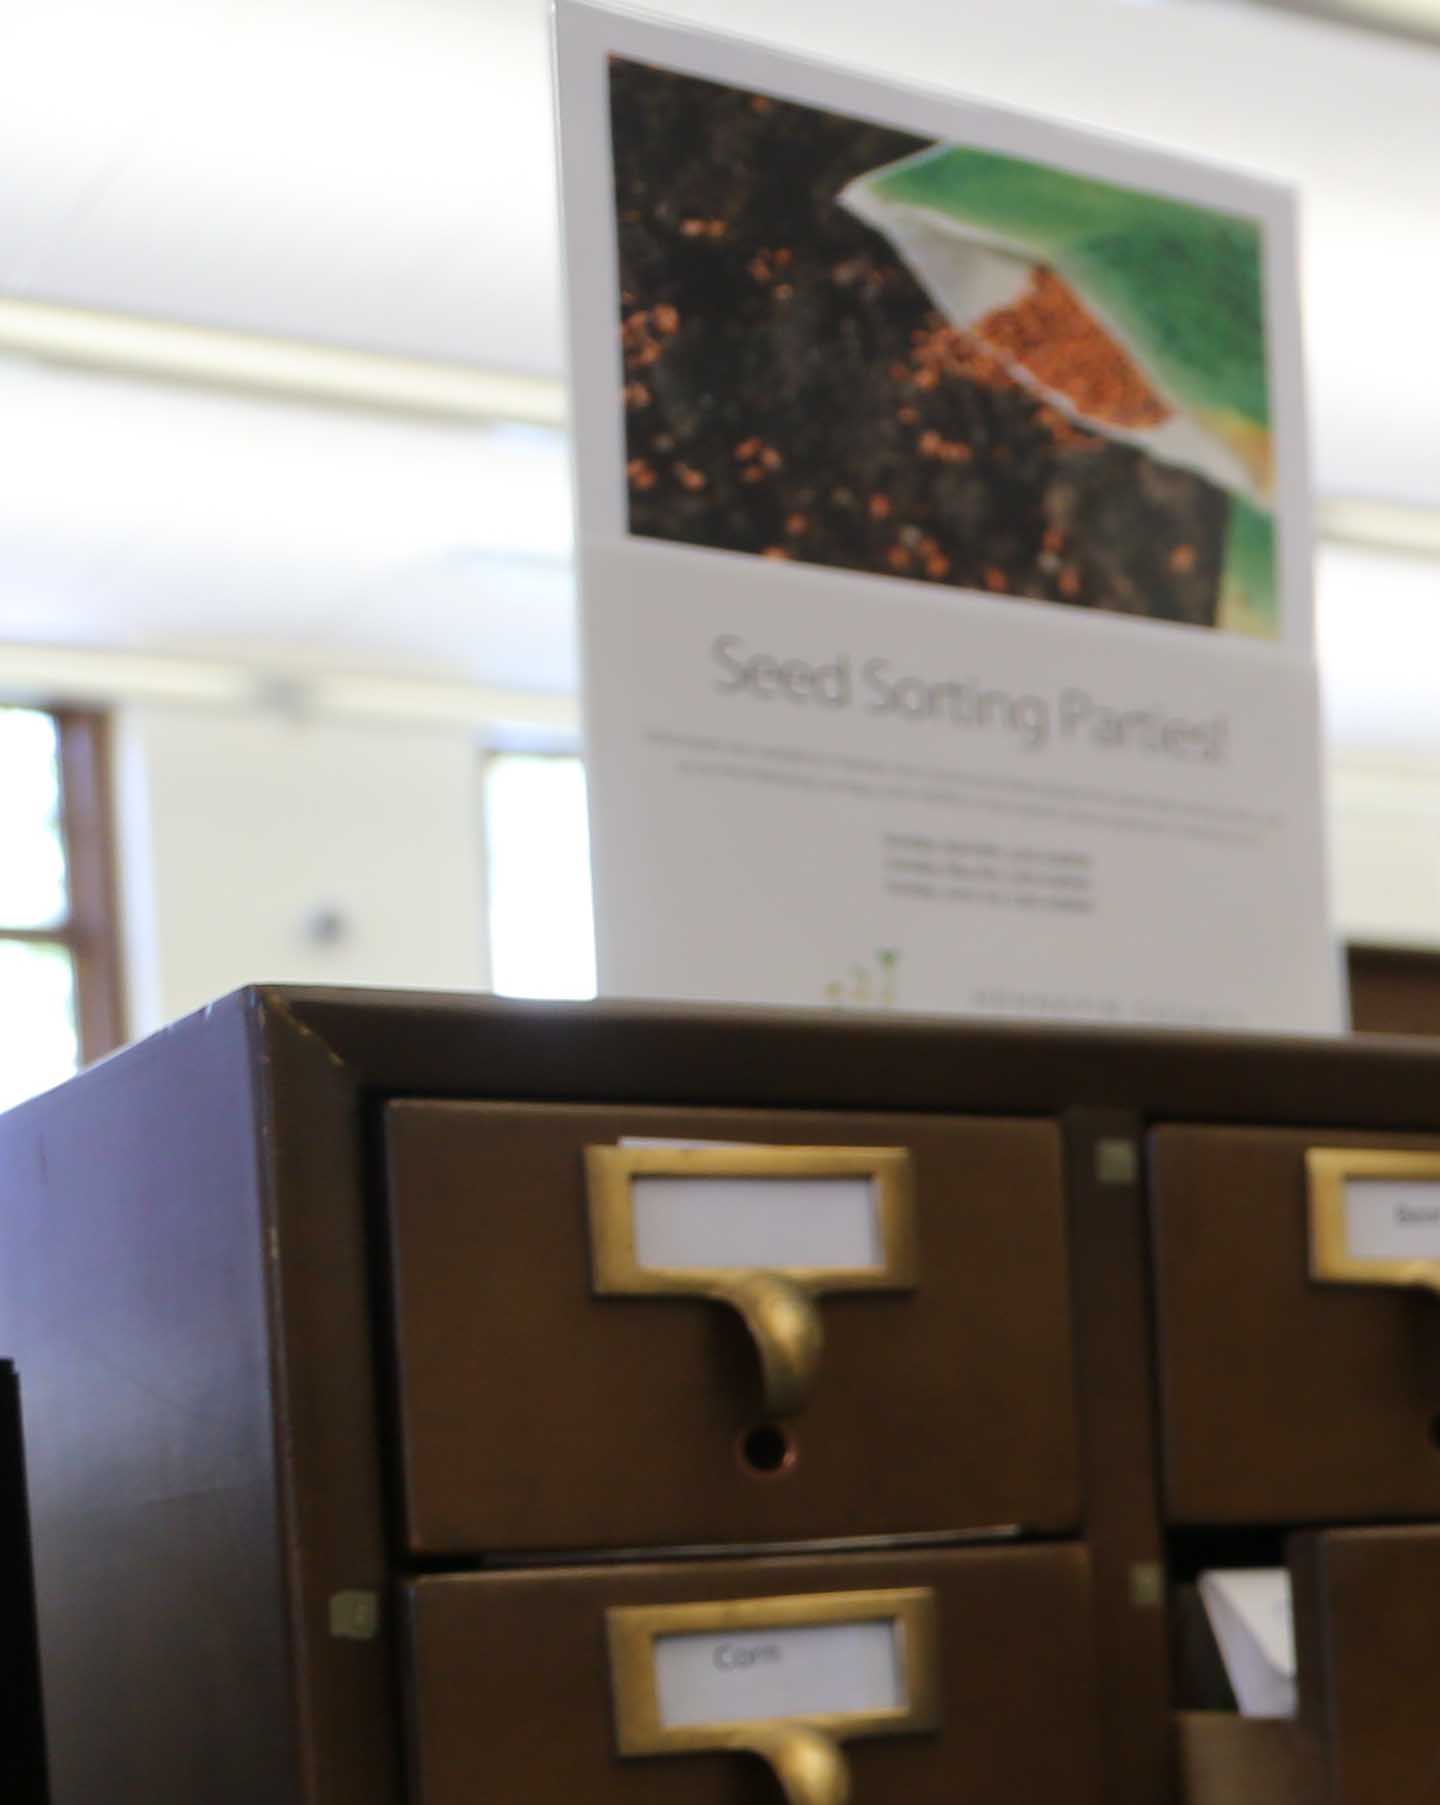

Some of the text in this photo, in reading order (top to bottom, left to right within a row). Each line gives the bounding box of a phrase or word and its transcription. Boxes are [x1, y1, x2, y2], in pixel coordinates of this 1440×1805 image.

[710, 633, 1230, 766] Seed Sorting Parties!
[712, 1644, 783, 1673] Corn
